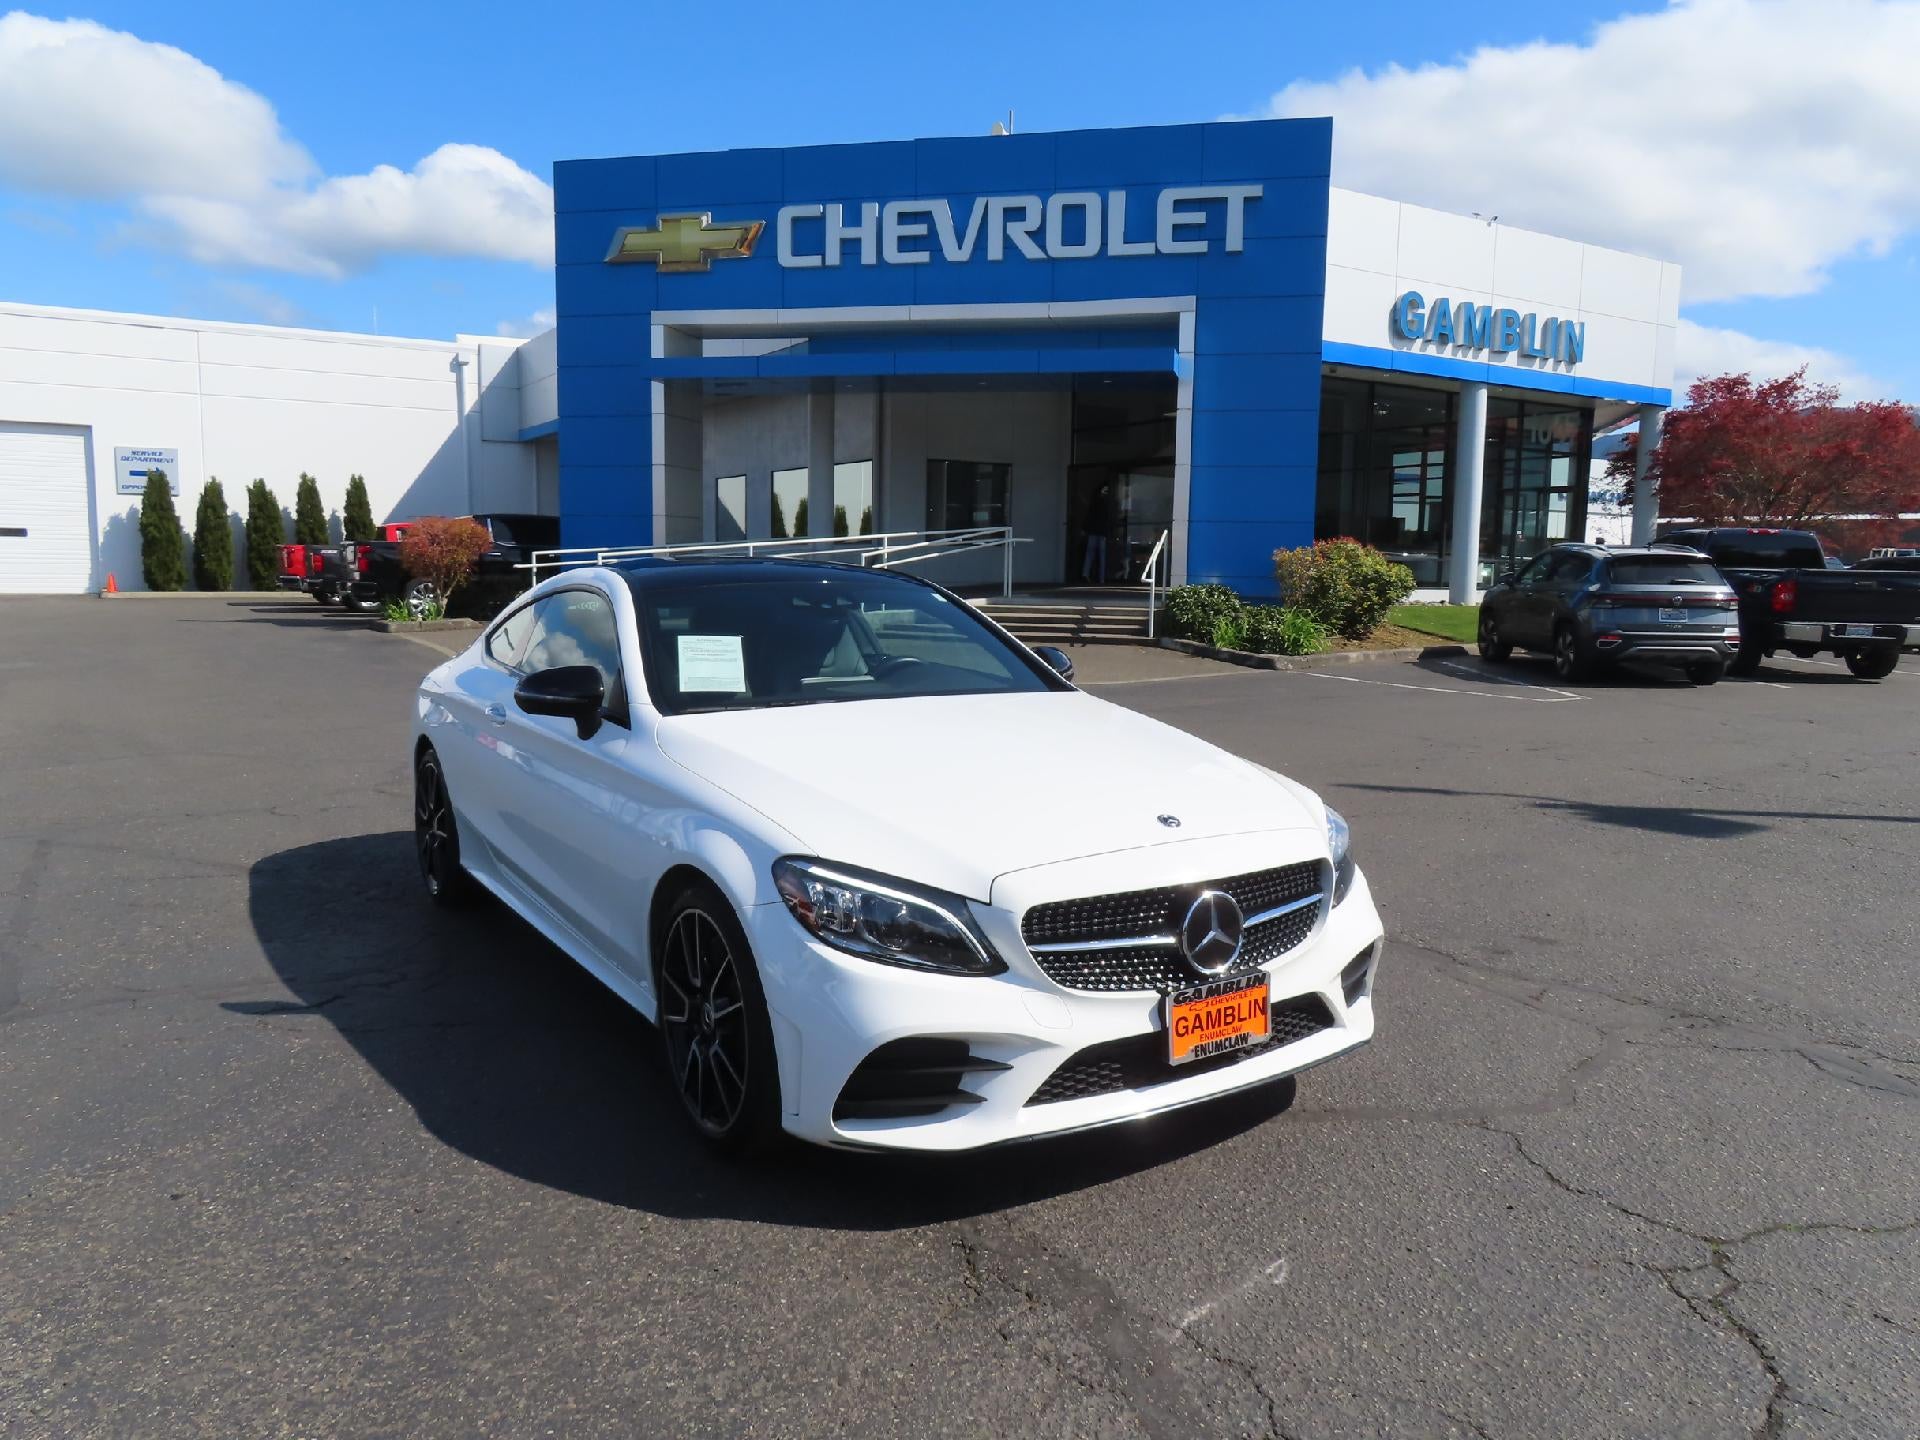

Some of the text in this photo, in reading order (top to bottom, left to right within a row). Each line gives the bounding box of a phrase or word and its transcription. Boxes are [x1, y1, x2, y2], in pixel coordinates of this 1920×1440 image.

[776, 184, 1264, 268] CHEVROLET
[1393, 290, 1585, 363] GAMBLIN
[120, 455, 174, 464] DEPARTMENT
[1173, 972, 1267, 1005] GAMBLIN
[1175, 995, 1267, 1038] GAMBLIN
[1199, 1024, 1243, 1042] ENUMCLAW
